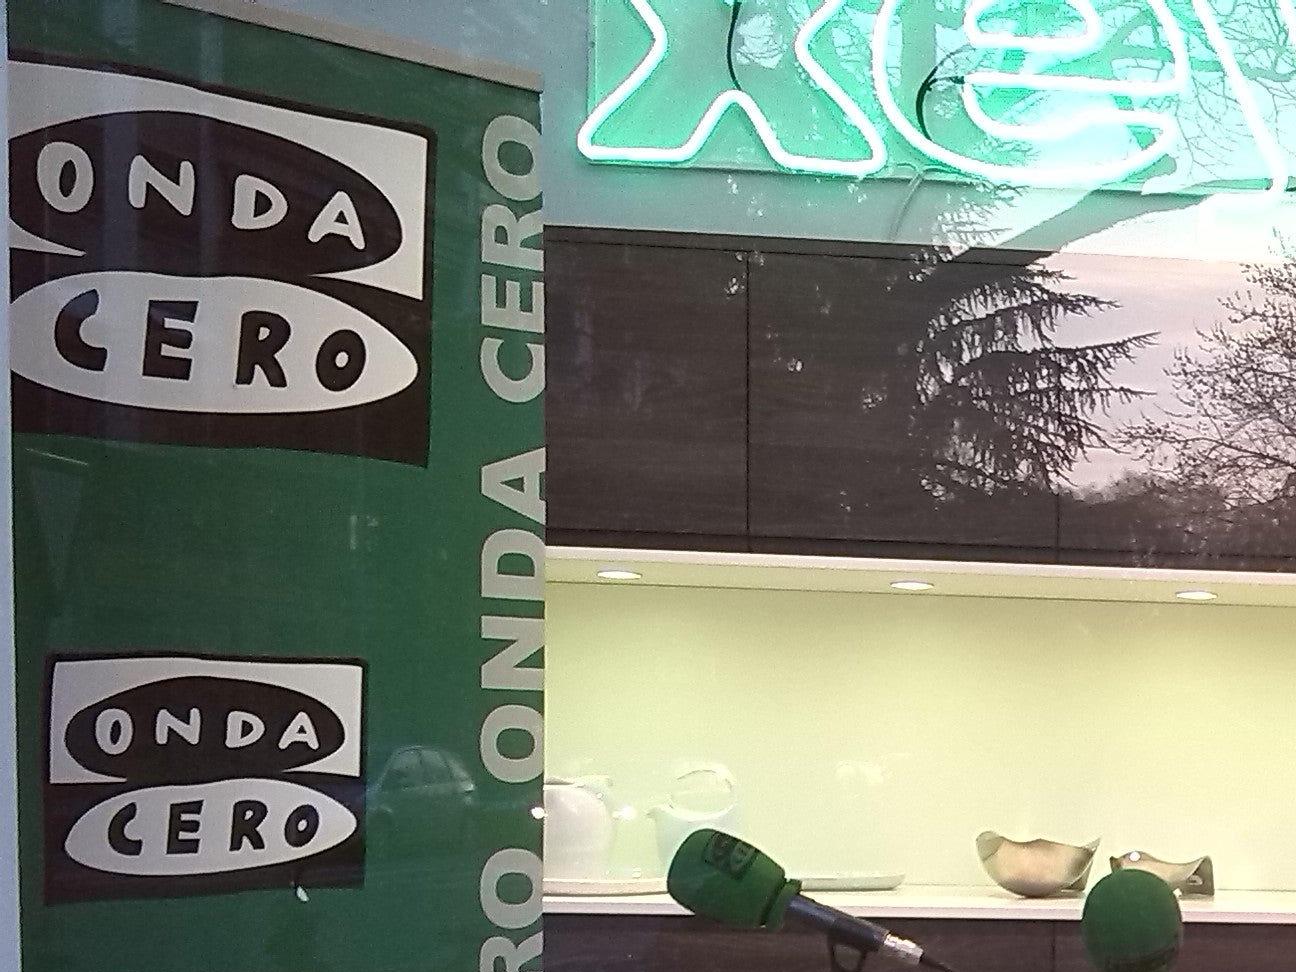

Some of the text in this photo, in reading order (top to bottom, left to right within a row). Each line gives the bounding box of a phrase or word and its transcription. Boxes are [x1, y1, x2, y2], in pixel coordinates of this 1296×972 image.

[36, 141, 366, 250] ONDA
[480, 115, 546, 403] CERO
[54, 289, 367, 392] CERO
[480, 446, 546, 783] ONDA
[95, 708, 319, 755] ONDA
[107, 798, 320, 856] CERO
